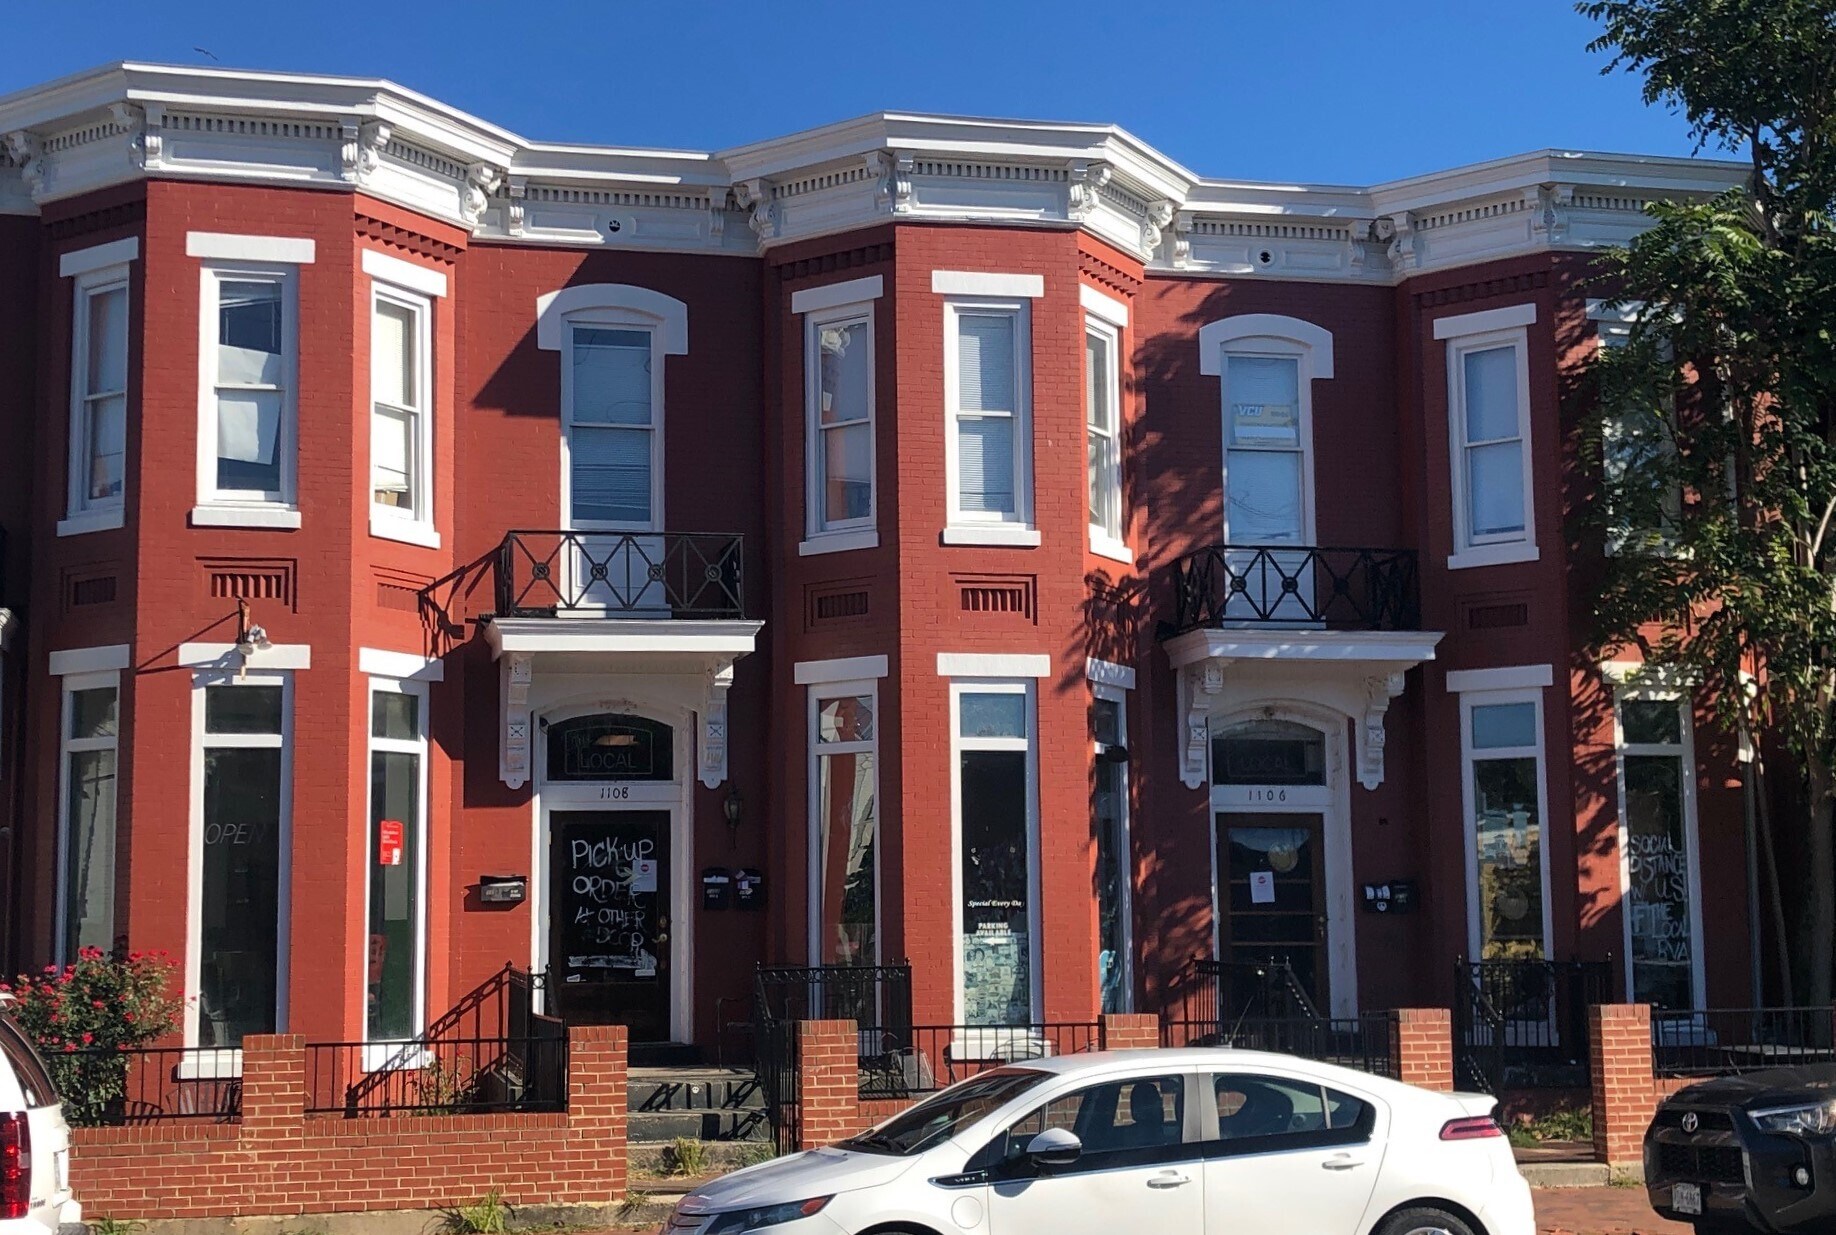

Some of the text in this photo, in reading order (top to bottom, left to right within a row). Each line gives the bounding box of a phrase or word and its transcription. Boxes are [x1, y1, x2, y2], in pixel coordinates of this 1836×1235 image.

[1238, 404, 1263, 416] VCU
[580, 752, 637, 769] LOCAL
[600, 786, 629, 799] 1108
[1248, 789, 1287, 802] 1106
[1630, 831, 1682, 855] SOCIAL
[967, 899, 992, 908] Special
[991, 900, 1011, 909] Every
[598, 907, 646, 930] OTHER
